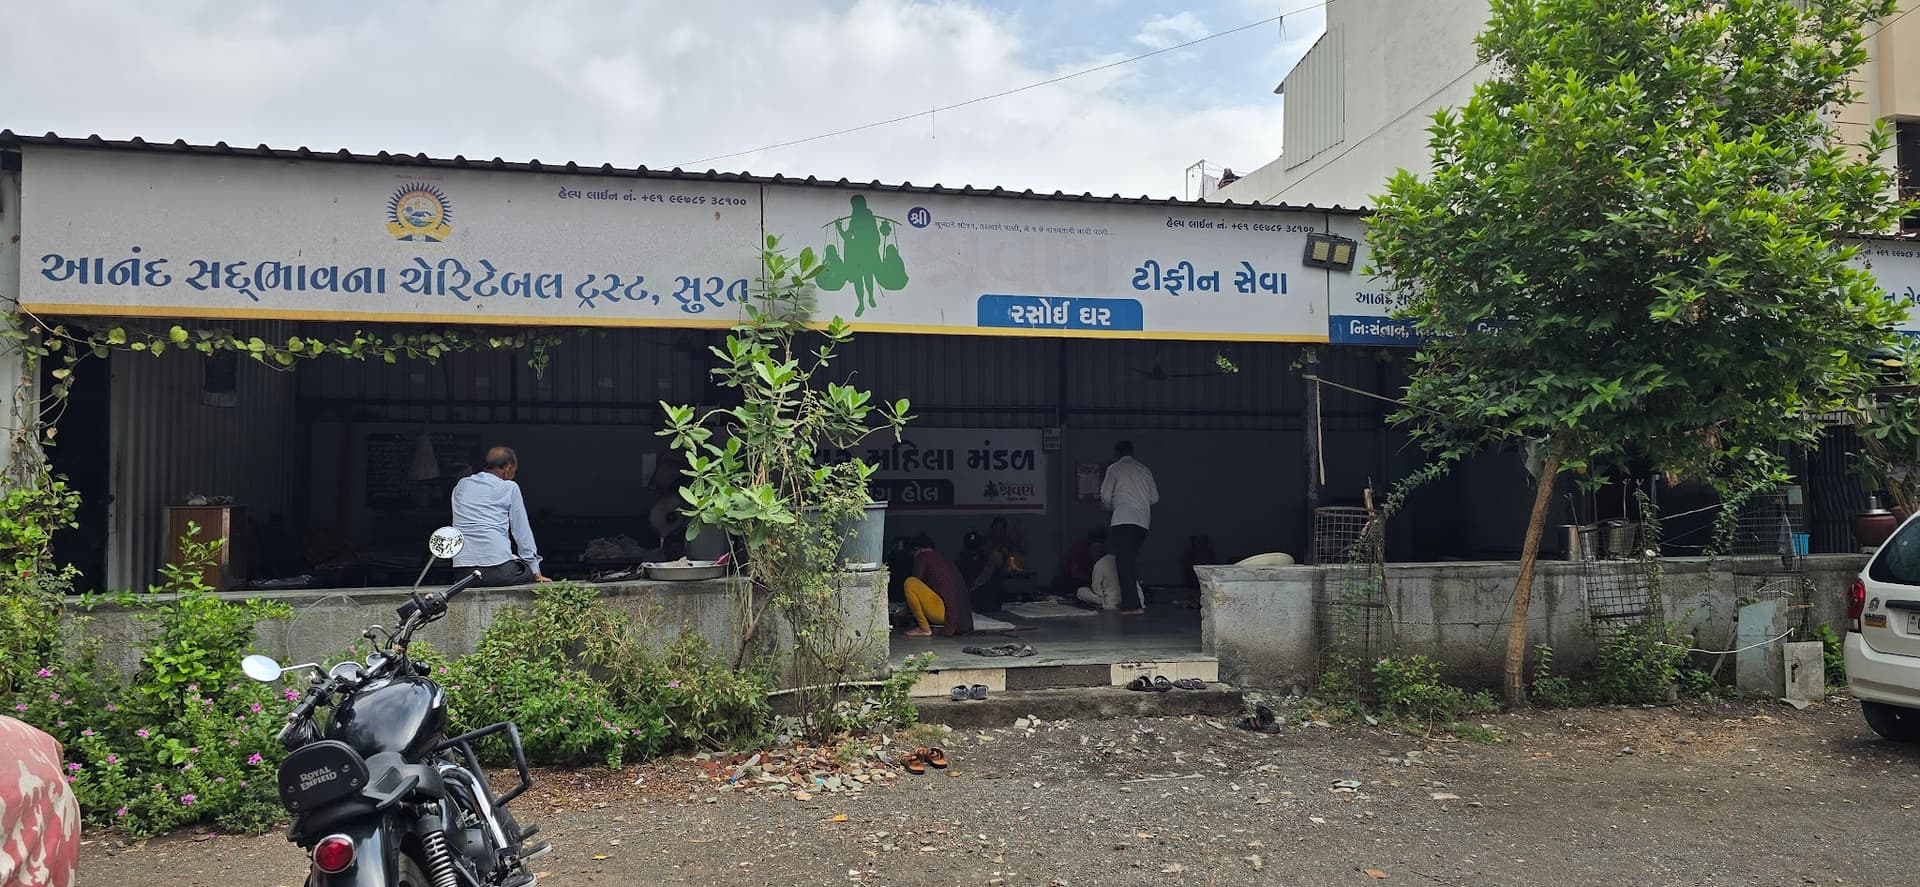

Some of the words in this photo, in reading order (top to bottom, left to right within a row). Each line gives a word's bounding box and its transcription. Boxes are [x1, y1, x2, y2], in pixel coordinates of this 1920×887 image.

[558, 186, 581, 199] હેલ્પ
[623, 190, 637, 202] નં.
[641, 193, 664, 203] +૯૧
[669, 193, 705, 204] ૯૯૭૮૬
[711, 195, 747, 206] ૩૮૧૦૦
[911, 208, 928, 226] શ્રી
[1166, 215, 1185, 227] હેલ્પ
[1231, 221, 1249, 231] +૯૧
[1286, 223, 1315, 234] ૩૮૧૦૦
[41, 247, 171, 286] આનંદ
[400, 257, 562, 302] ચેરિટેબલ
[575, 273, 659, 309] ટ્રસ્ટ,
[671, 275, 750, 314] સુરત
[1131, 260, 1220, 296] ટીફીન
[1234, 261, 1286, 294] સેવા
[1010, 298, 1070, 326] રસોઈ
[1079, 304, 1112, 326] ઘર
[866, 439, 955, 473] મહિલા
[967, 440, 1035, 471] મંડળ
[901, 480, 939, 503] હોલ
[299, 766, 331, 783] ROYAL
[300, 771, 337, 791] ENFIELD
